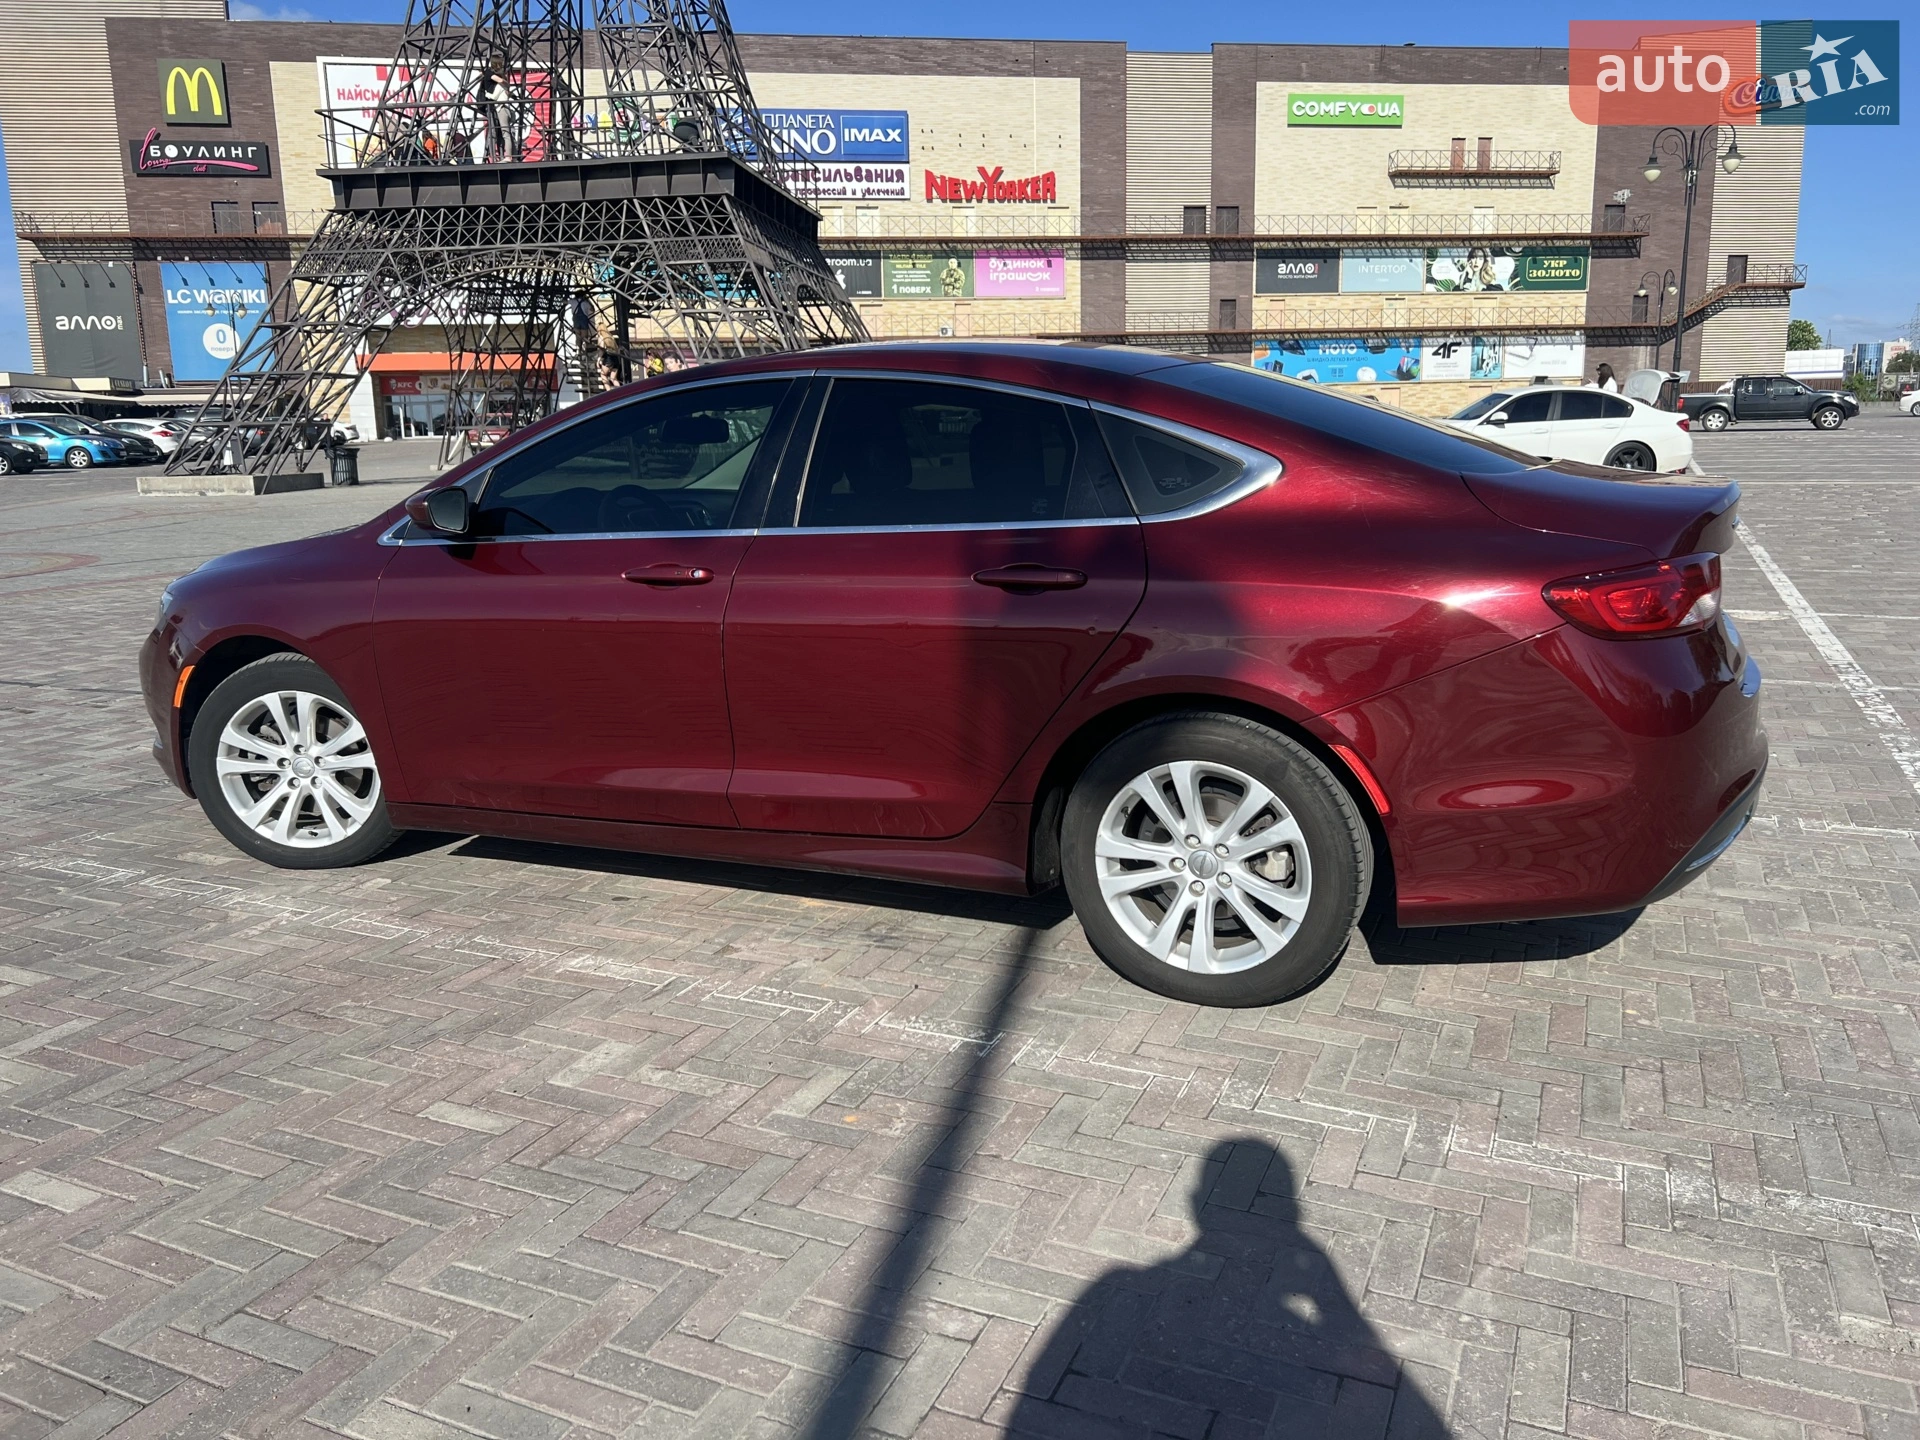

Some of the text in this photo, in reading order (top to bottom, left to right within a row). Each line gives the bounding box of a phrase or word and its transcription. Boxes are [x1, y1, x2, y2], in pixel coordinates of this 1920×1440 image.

[764, 128, 902, 154] KINO IMAX
[150, 145, 257, 158] БОУЛИНГ
[861, 187, 905, 198] увлечений
[989, 257, 1044, 271] будинок
[1358, 265, 1407, 274] INTERTOP
[1543, 260, 1568, 268] УКР
[1529, 268, 1581, 278] ЗОЛОТО
[892, 284, 932, 294] 1 ПОВЕРХ
[166, 289, 192, 304] LC
[216, 329, 227, 344] 0
[1432, 342, 1462, 359] 4F
